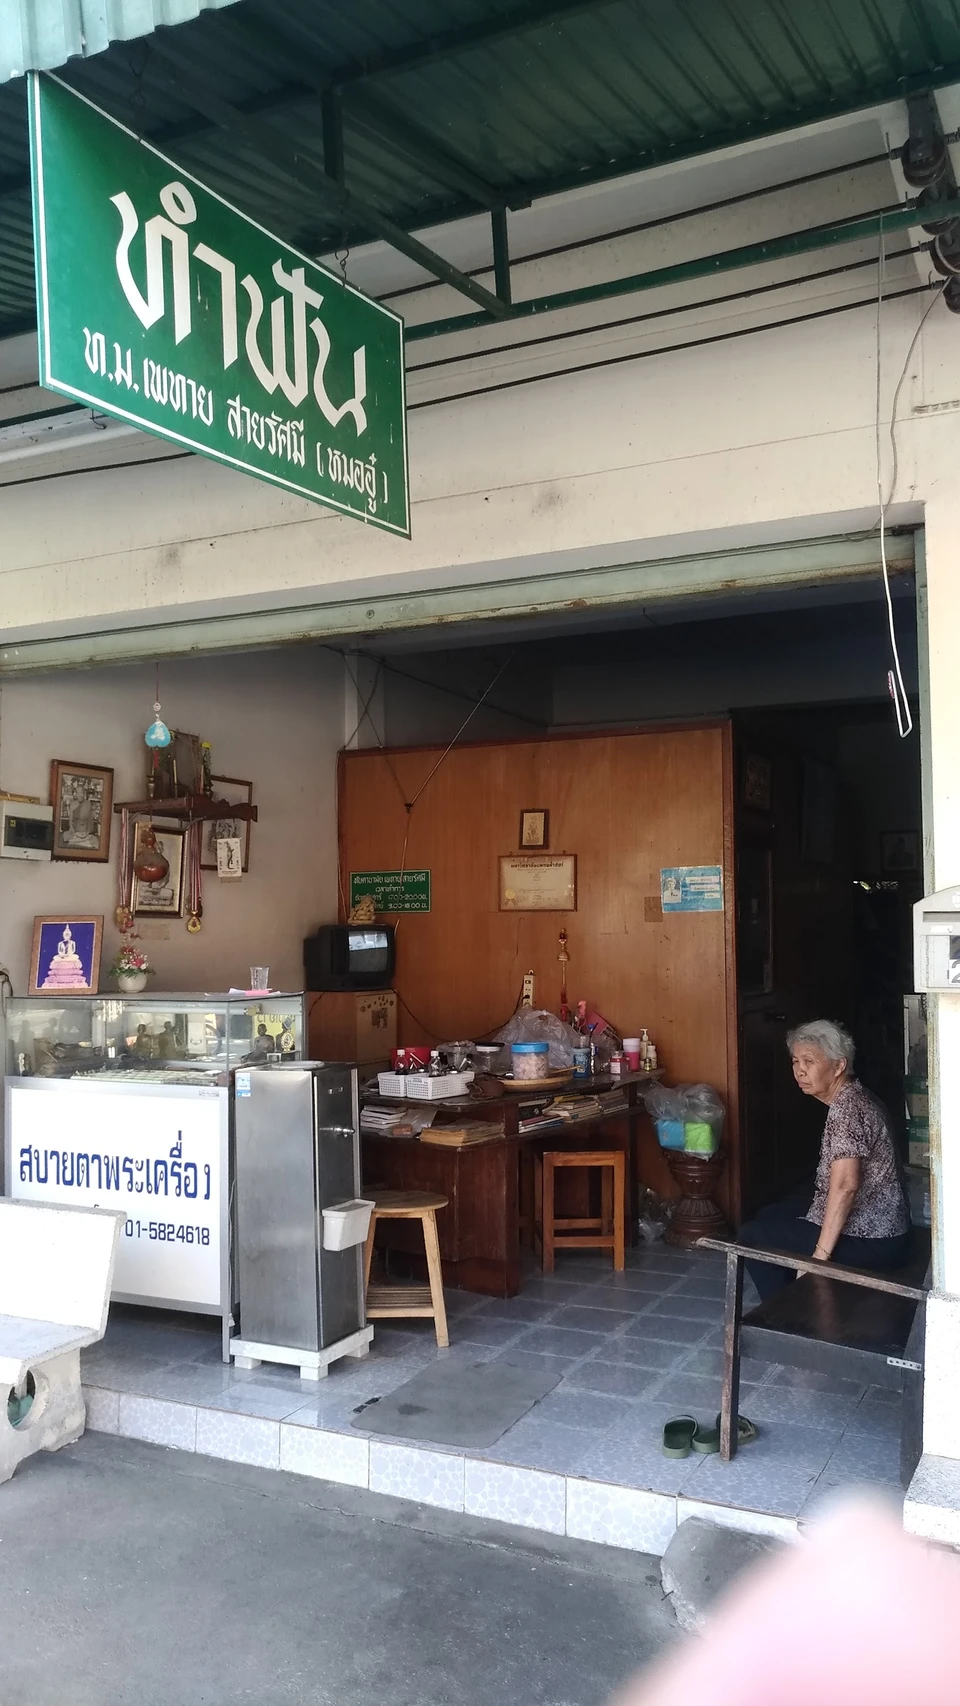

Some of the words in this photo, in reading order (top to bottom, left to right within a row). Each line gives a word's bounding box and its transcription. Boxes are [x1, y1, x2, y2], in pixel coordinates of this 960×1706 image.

[110, 181, 368, 437] ทำฟัน
[226, 394, 306, 468] สายรัศมี
[19, 1130, 211, 1200] สบายตาพระเครื่อง
[125, 1219, 210, 1245] 01-5824618
